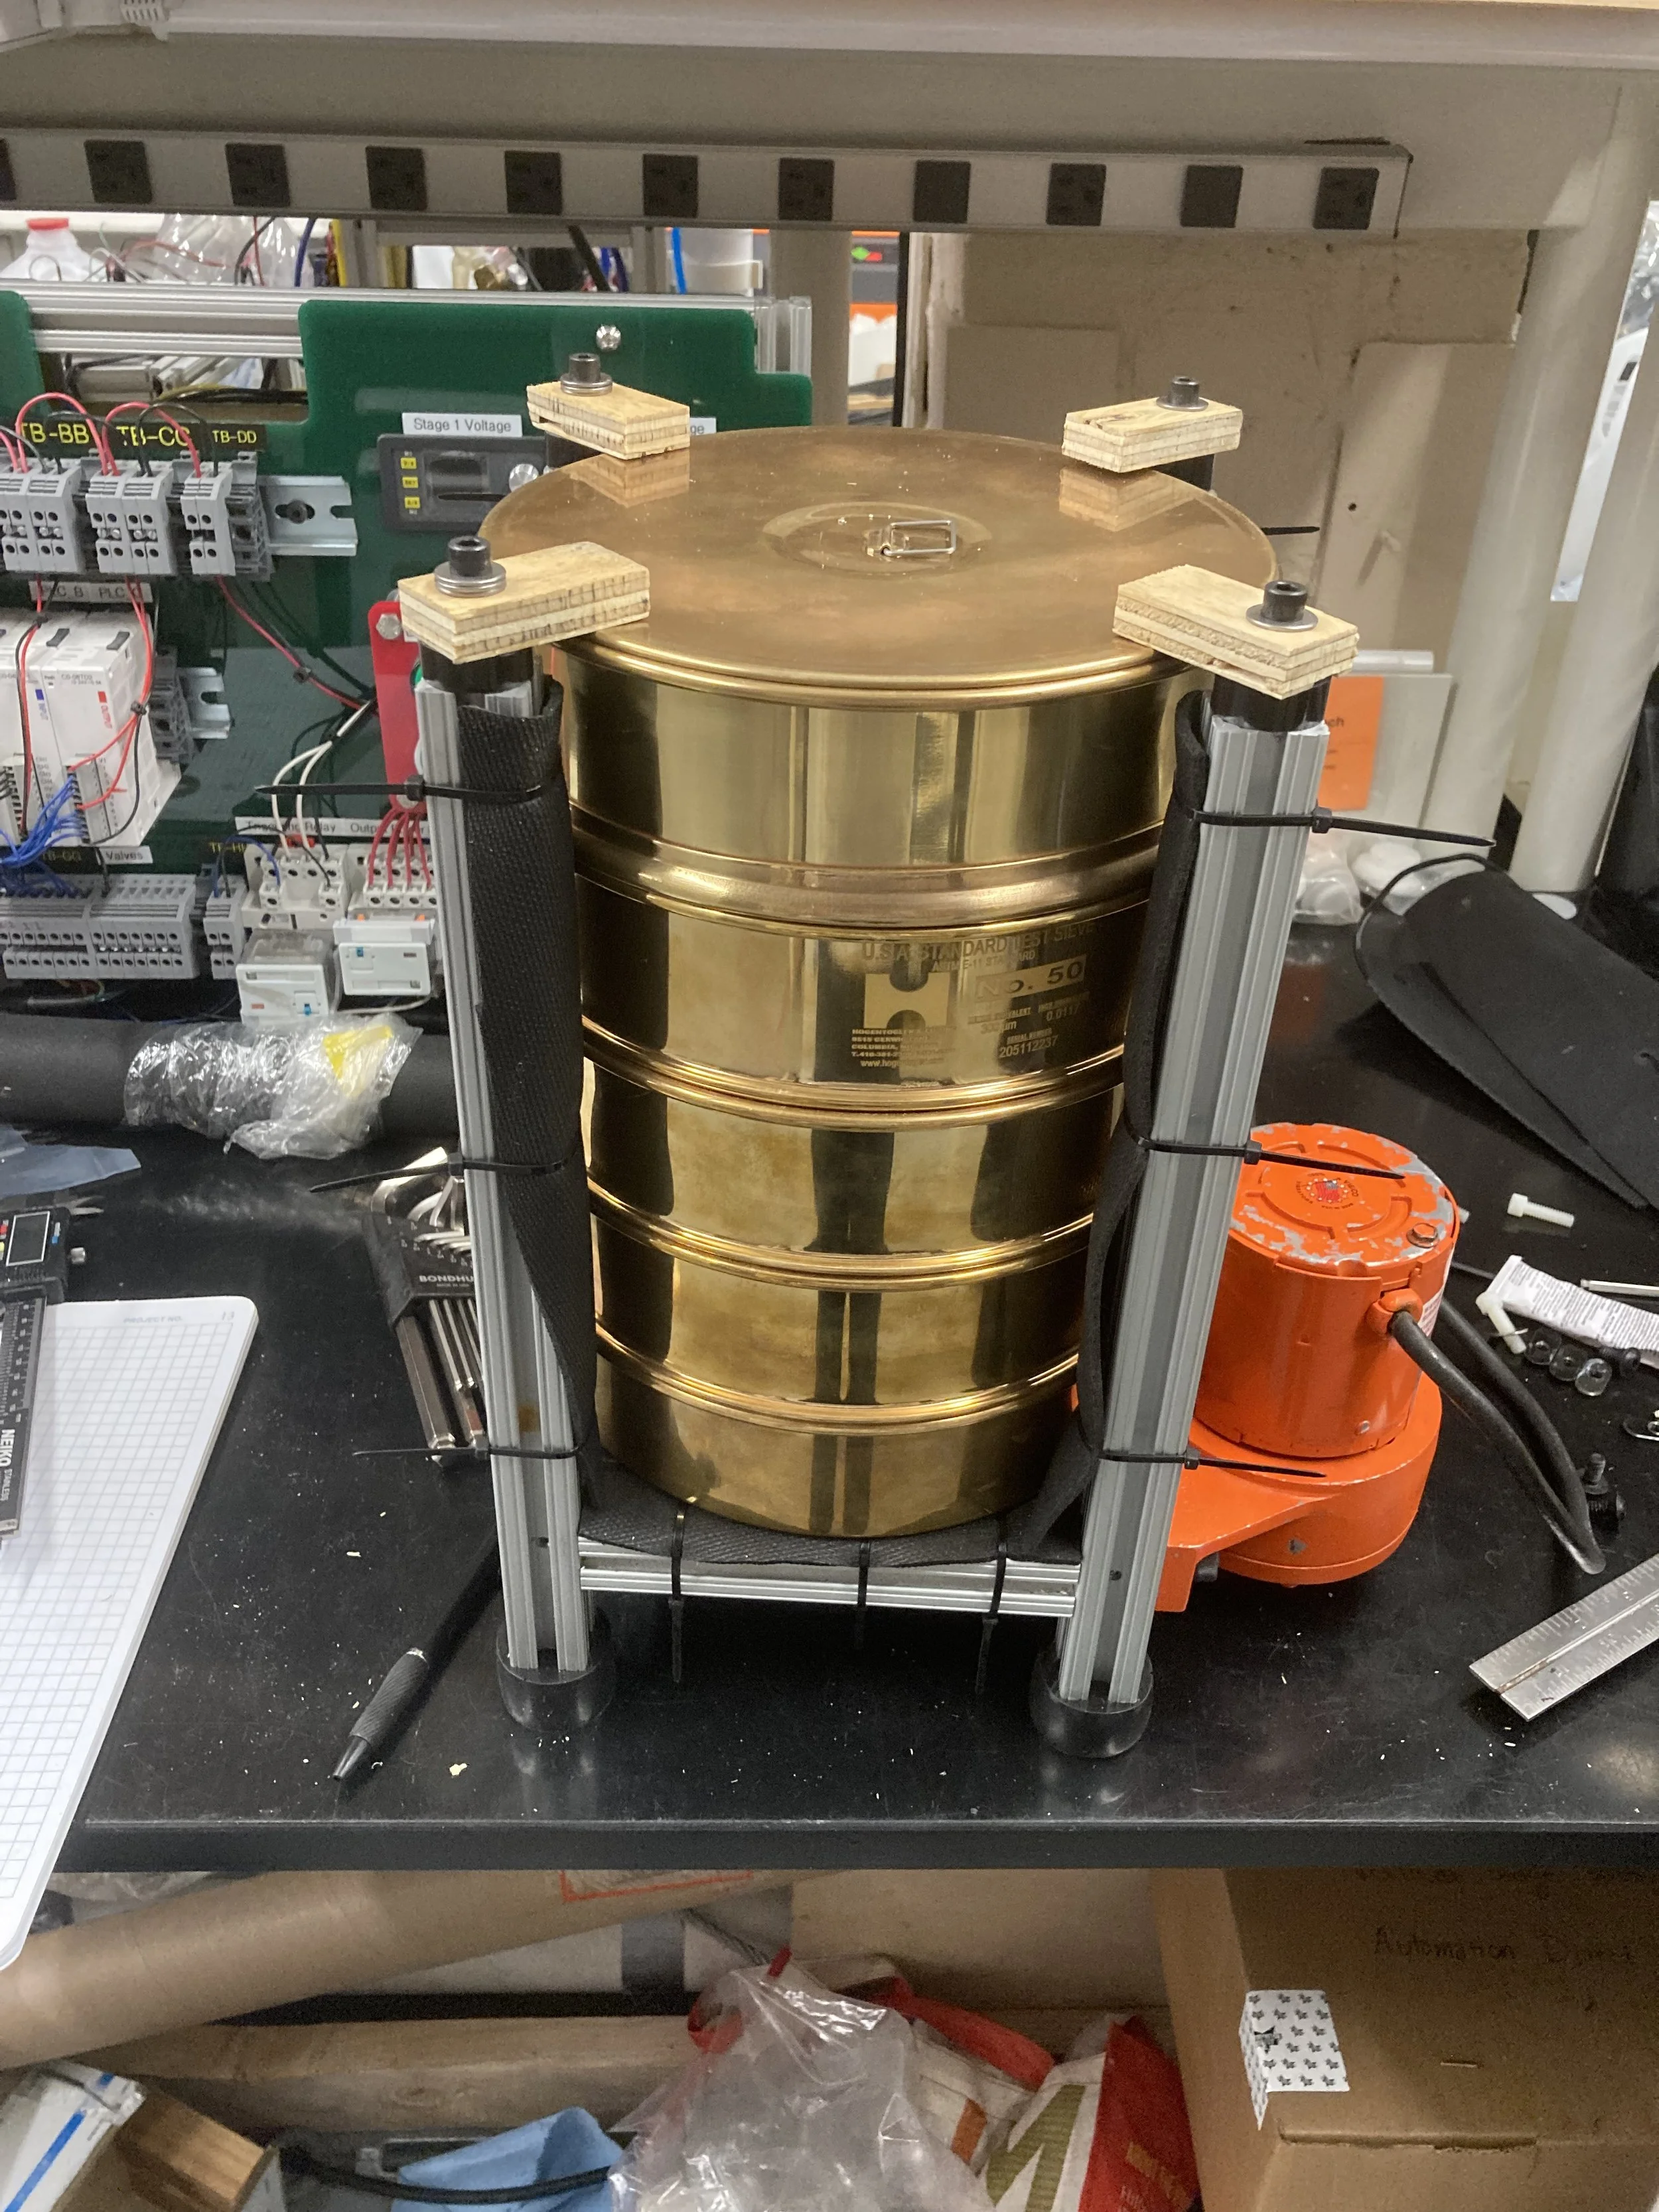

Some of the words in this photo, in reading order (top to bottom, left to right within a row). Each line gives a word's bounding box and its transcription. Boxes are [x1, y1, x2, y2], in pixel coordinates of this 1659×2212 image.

[413, 417, 450, 432] Stage
[455, 419, 459, 431] 1
[465, 419, 512, 433] Voltage
[212, 429, 257, 443] TB-DD
[105, 850, 144, 861] Valves
[1047, 961, 1084, 985] 50
[999, 1035, 1059, 1059] 205112237
[0, 1428, 16, 1467] NEIKO
